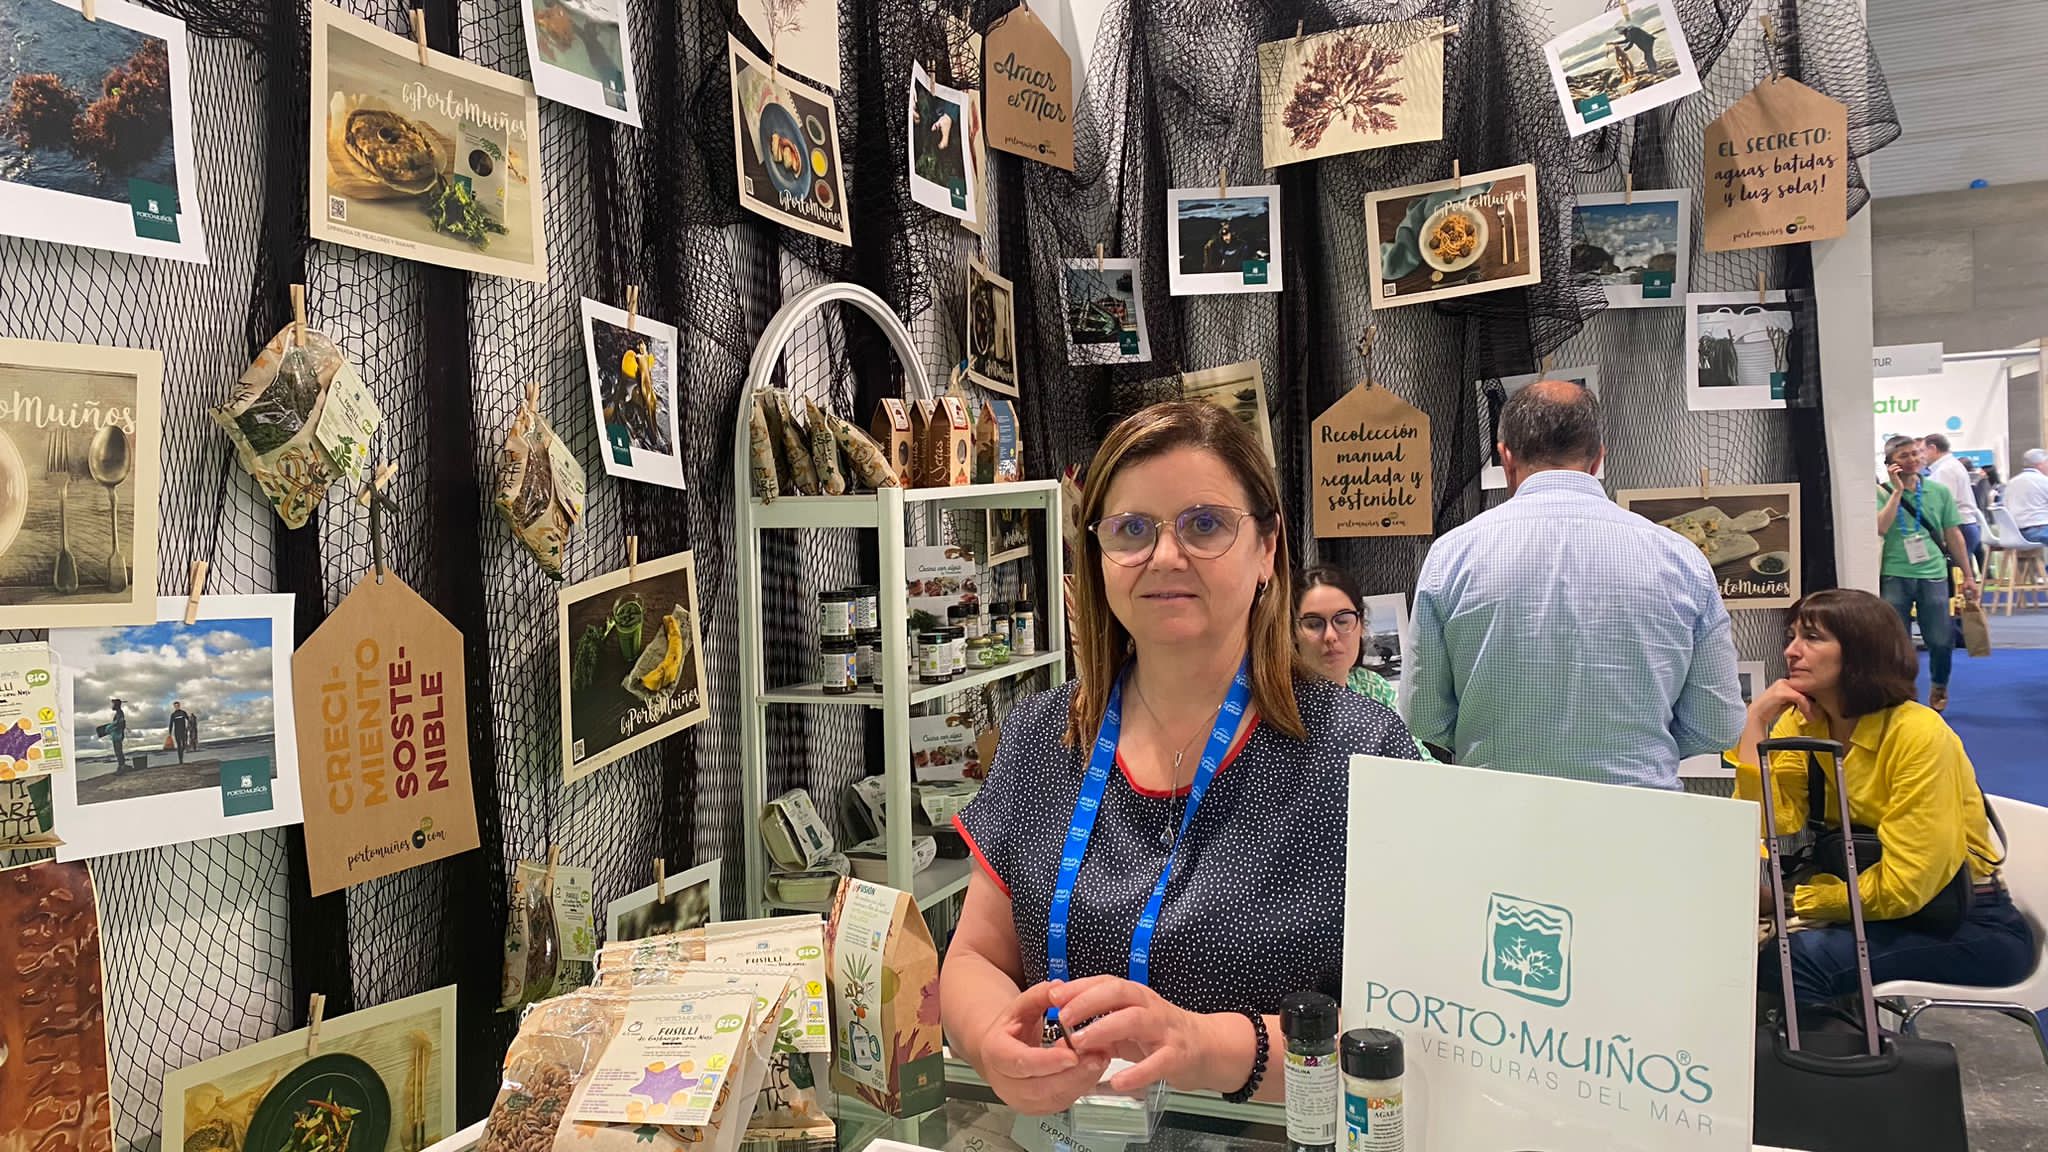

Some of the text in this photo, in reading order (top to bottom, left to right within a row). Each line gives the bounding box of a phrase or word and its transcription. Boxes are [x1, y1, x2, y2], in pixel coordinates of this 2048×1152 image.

[993, 52, 1056, 92] Amar
[402, 82, 528, 140] byPortoMuiños
[1008, 89, 1066, 122] el Mar
[1718, 128, 1831, 157] EL SECRETO:
[1715, 153, 1838, 188] aguas batidas
[1724, 174, 1825, 207] y luz solar!
[1873, 395, 1920, 413] atur
[1322, 422, 1418, 443] Recolección
[1337, 443, 1406, 463] manual
[1321, 466, 1423, 495] regulada y
[1329, 487, 1416, 511] sostenible
[355, 638, 388, 807] MIENTO
[389, 646, 419, 799] SOSTE-
[620, 687, 700, 736] byPortoMuiños
[321, 664, 354, 815] CRECI-
[421, 671, 449, 791] NIBLE
[347, 839, 410, 871] portomuiños
[658, 1026, 699, 1036] FUSILLI
[1421, 1036, 1558, 1090] VERDURAS
[1577, 1080, 1630, 1111] DEL
[1650, 1100, 1713, 1136] MAR
